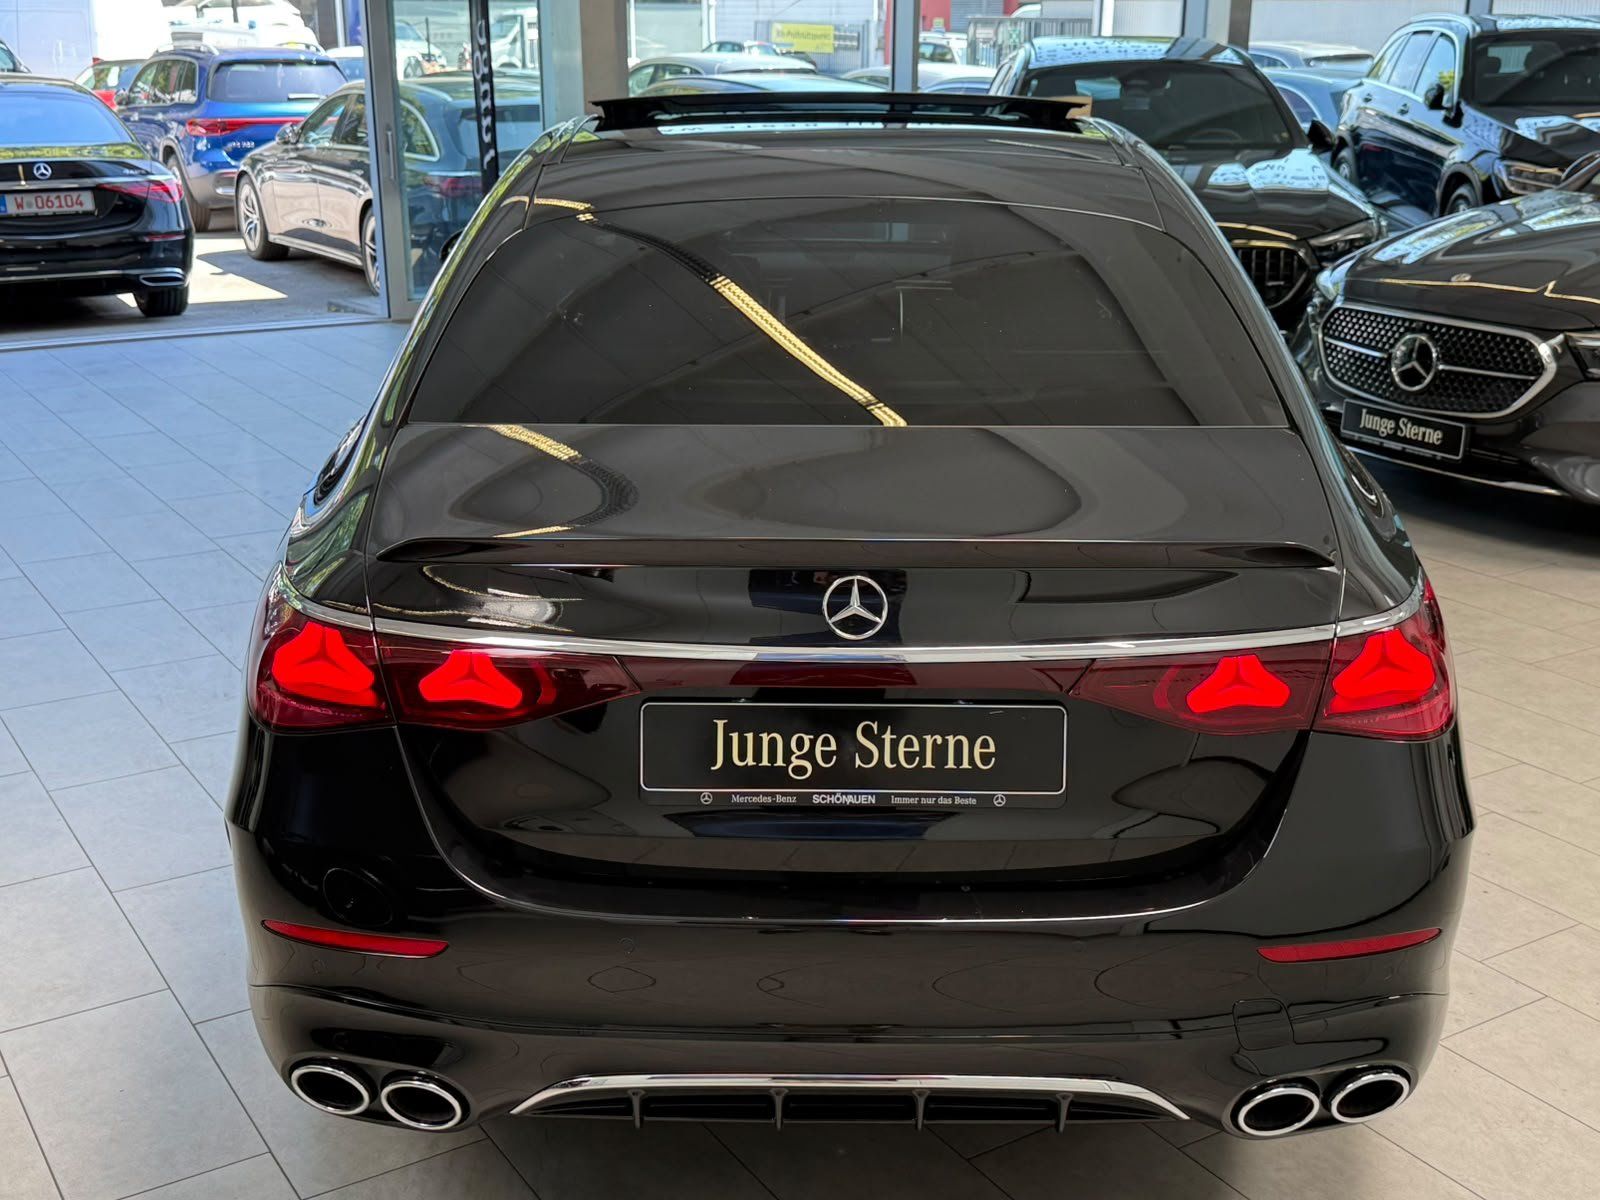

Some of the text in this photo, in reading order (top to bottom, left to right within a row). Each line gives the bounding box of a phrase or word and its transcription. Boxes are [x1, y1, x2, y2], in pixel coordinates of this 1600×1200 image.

[14, 194, 84, 210] W 06104
[1360, 408, 1443, 445] Junge Sterne
[710, 719, 997, 780] Junge Sterne
[731, 794, 797, 804] Mercedes-Benz
[890, 795, 977, 806] Immer nur das Beste
